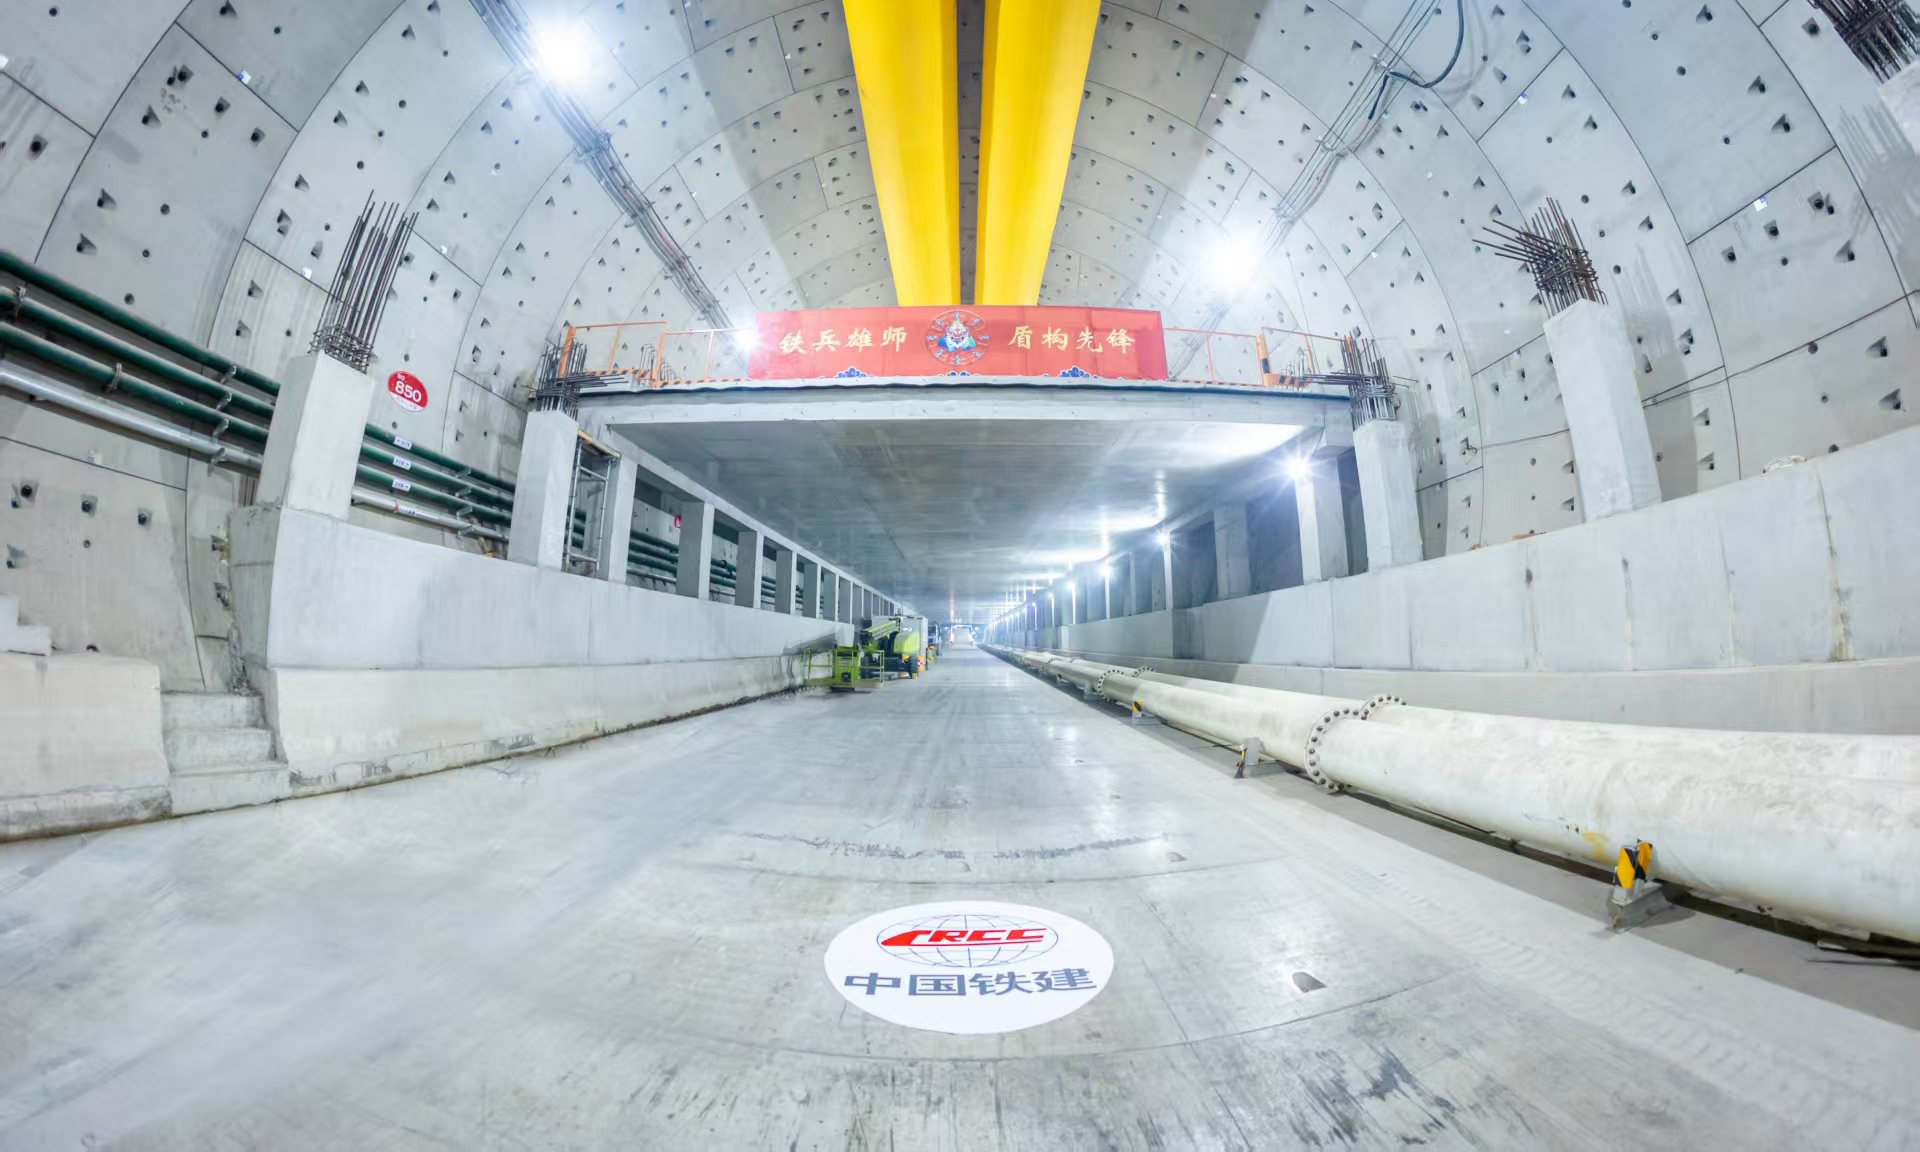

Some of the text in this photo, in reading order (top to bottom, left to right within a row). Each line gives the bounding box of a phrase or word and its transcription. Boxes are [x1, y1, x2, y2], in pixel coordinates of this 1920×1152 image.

[779, 326, 908, 354] 铁兵雄师
[1007, 326, 1136, 354] 盾构先锋
[394, 380, 422, 403] 850
[881, 927, 1047, 947] CRCC
[843, 967, 1097, 996] 中国铁建
